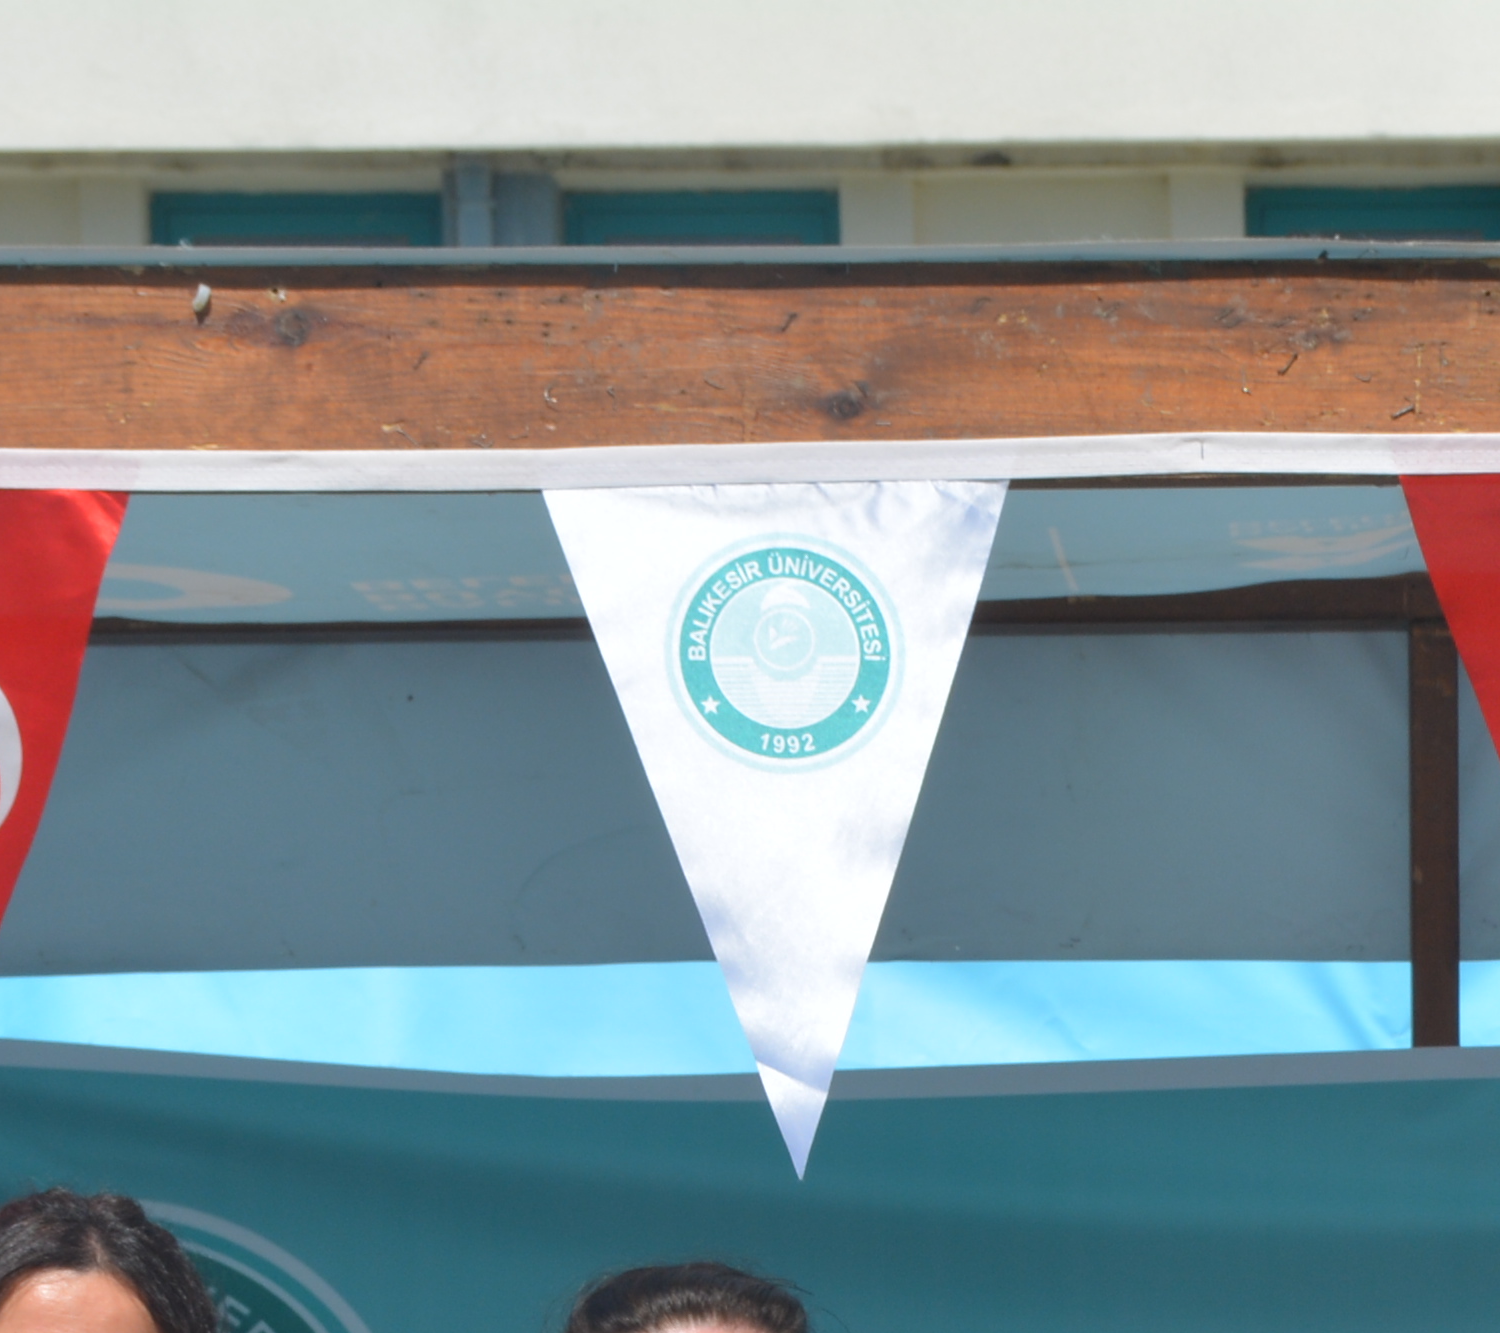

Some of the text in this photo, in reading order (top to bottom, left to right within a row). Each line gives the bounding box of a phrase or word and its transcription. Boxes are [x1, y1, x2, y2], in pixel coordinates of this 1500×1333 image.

[687, 551, 887, 663] BALIKESİR ÜNİVERSİTESİ
[760, 732, 816, 754] 1992
